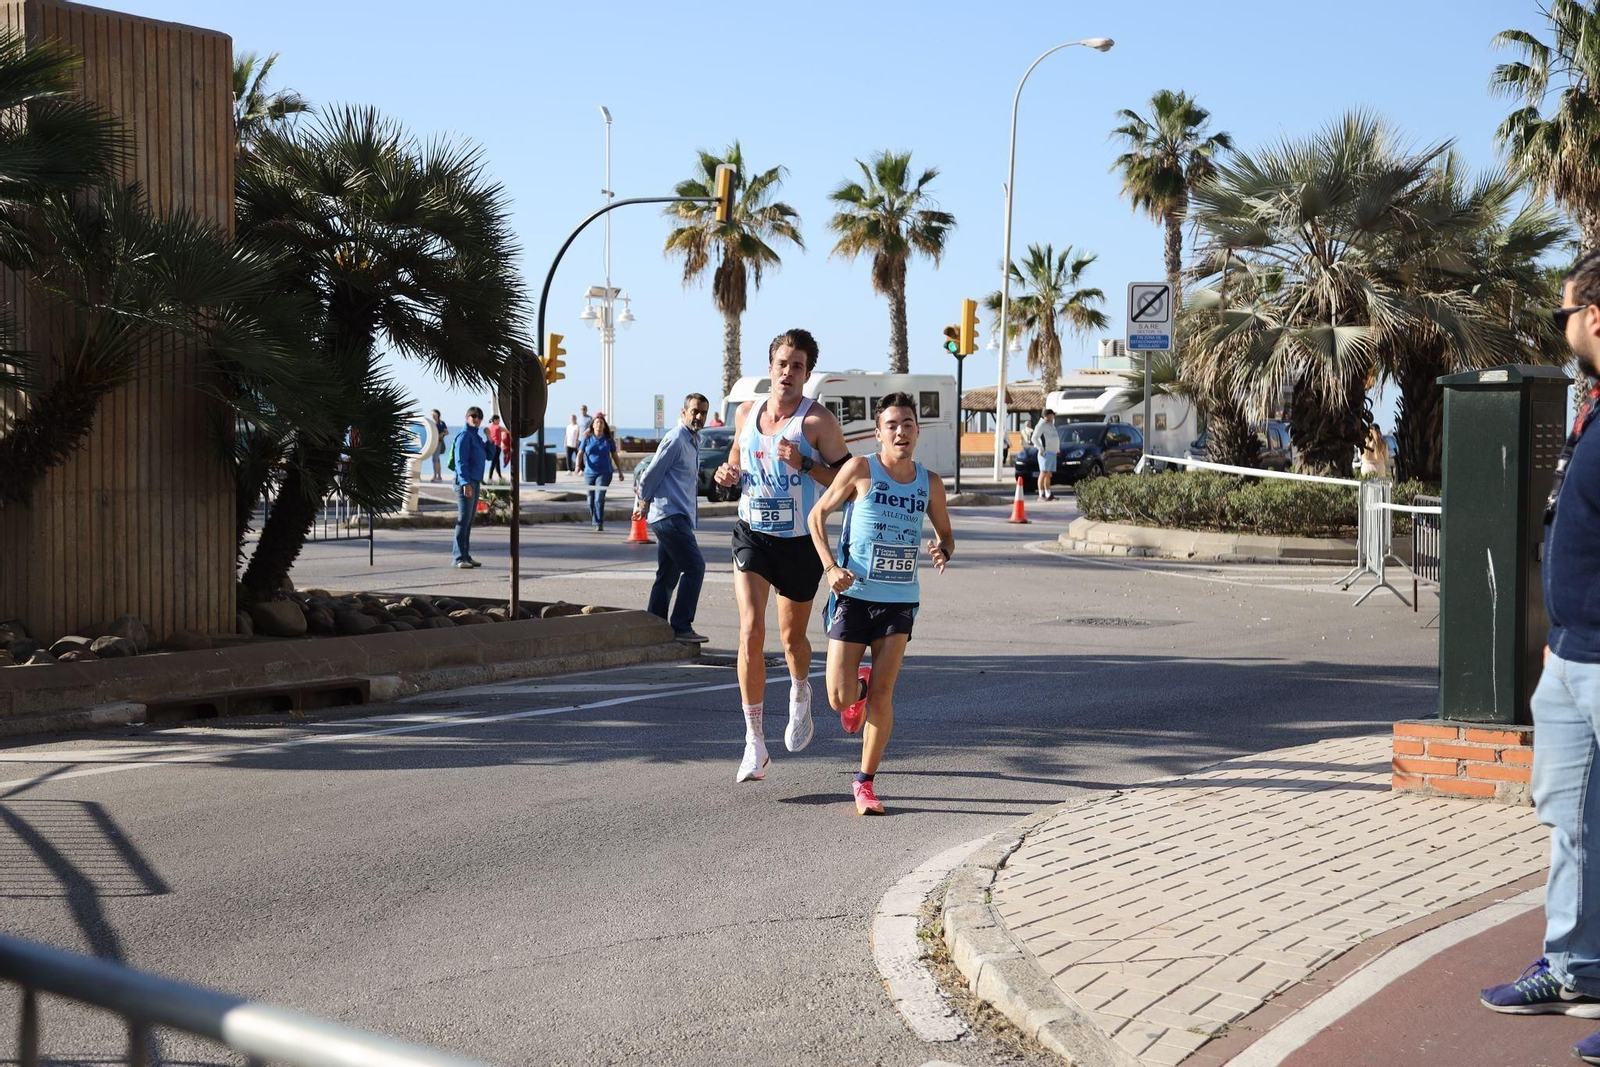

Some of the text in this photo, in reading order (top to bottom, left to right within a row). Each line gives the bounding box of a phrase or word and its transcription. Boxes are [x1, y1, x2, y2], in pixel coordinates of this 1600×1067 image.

[874, 492, 925, 514] nerja
[762, 511, 780, 521] 26
[880, 510, 918, 524] ATLETISMO
[876, 558, 912, 570] 2156
